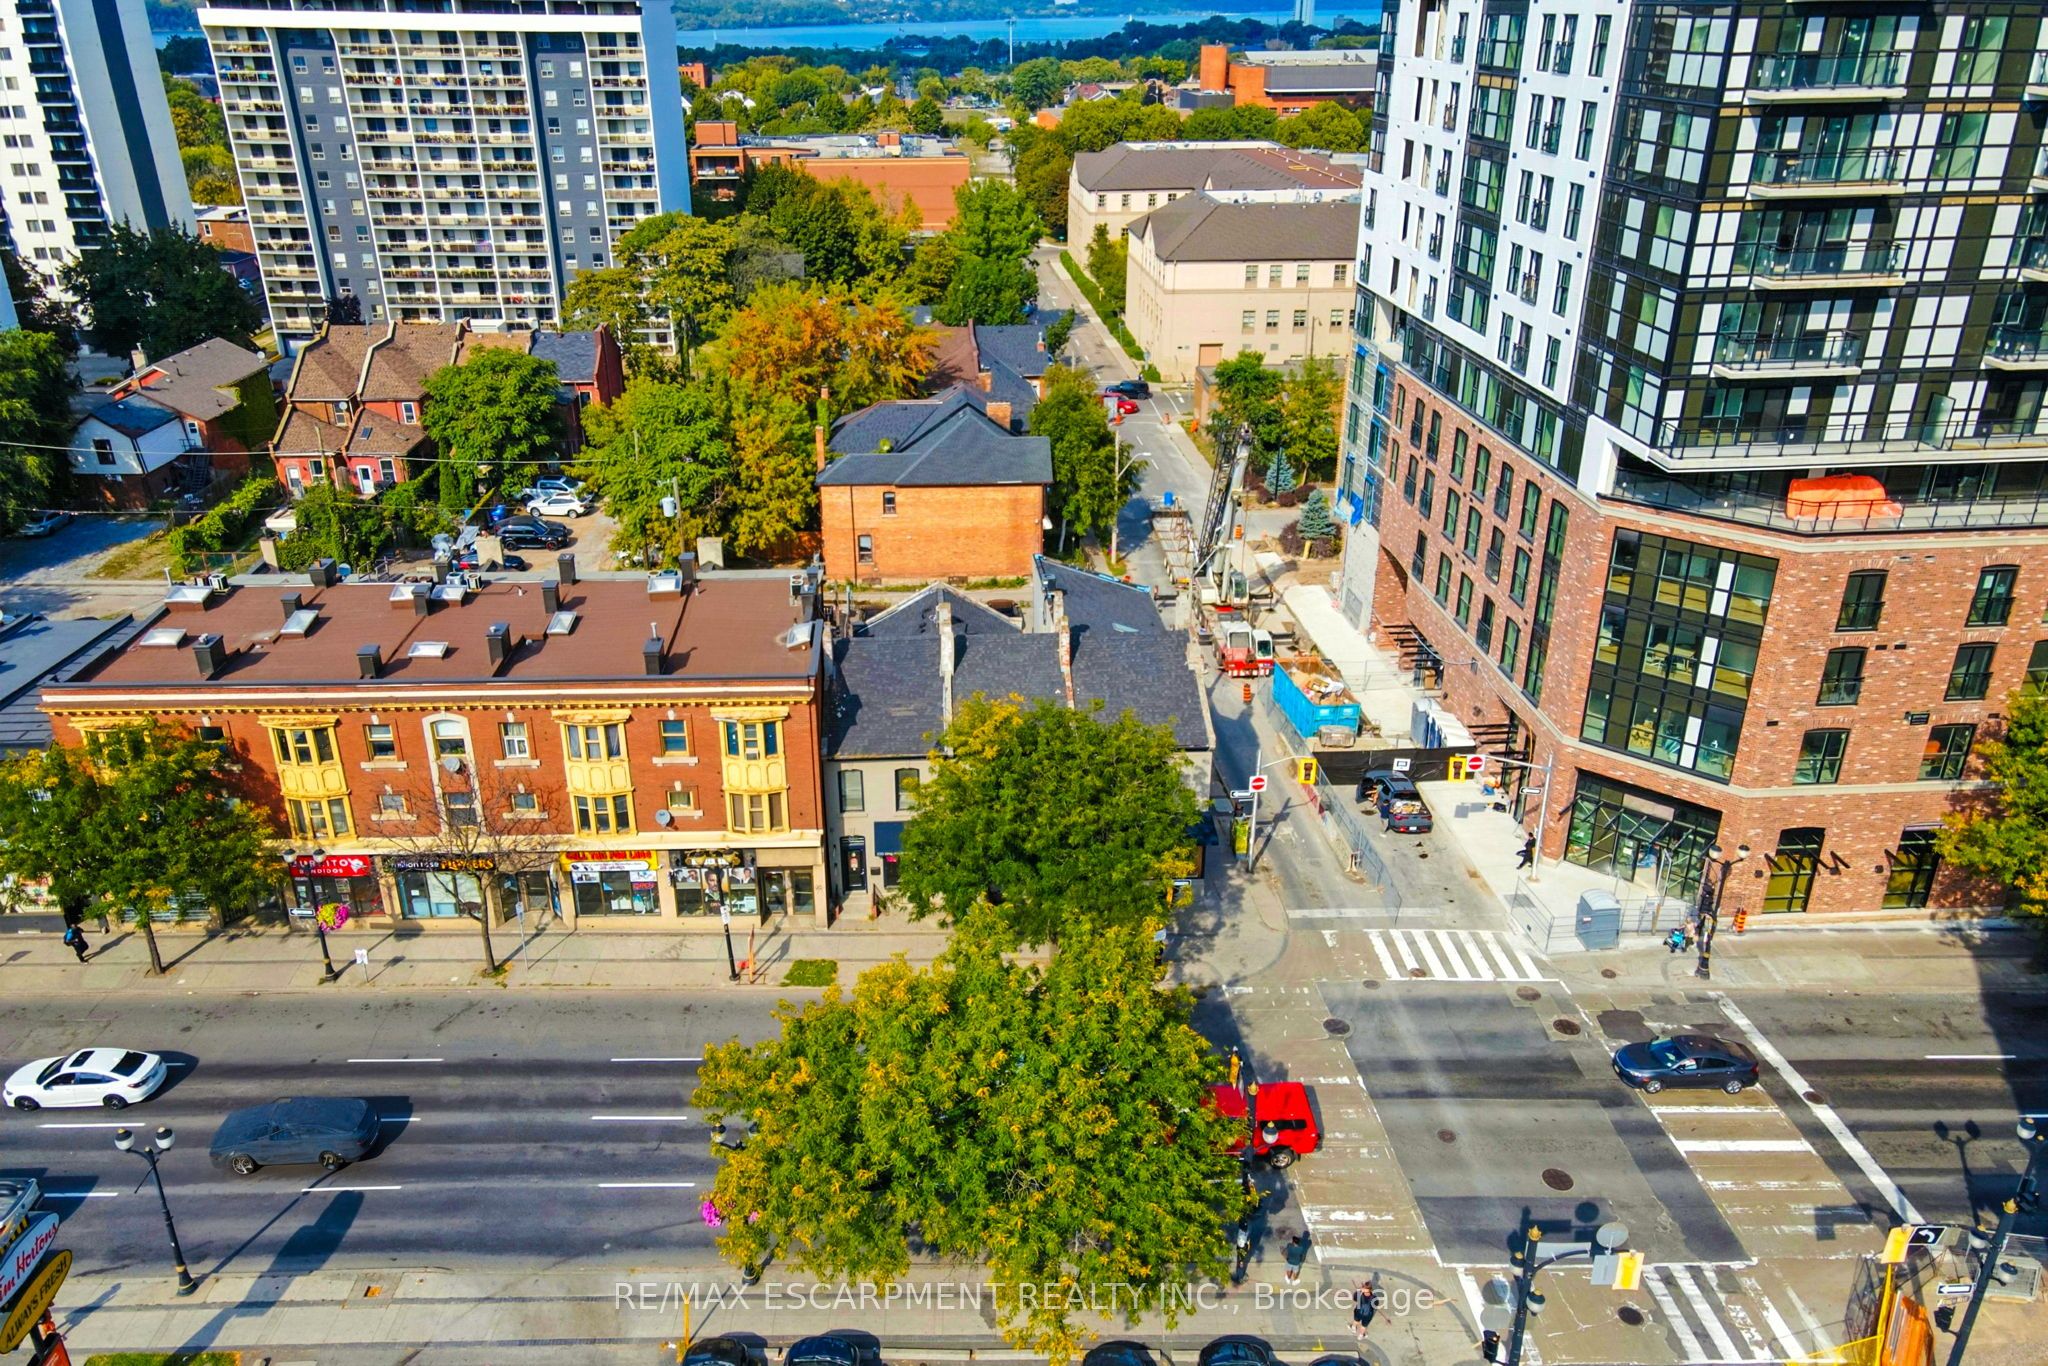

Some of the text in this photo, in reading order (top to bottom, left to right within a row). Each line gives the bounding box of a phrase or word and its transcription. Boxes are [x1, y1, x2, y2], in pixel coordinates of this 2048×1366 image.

[16, 1222, 58, 1280] Hortons
[5, 1256, 68, 1348] ALWAYS FRESH
